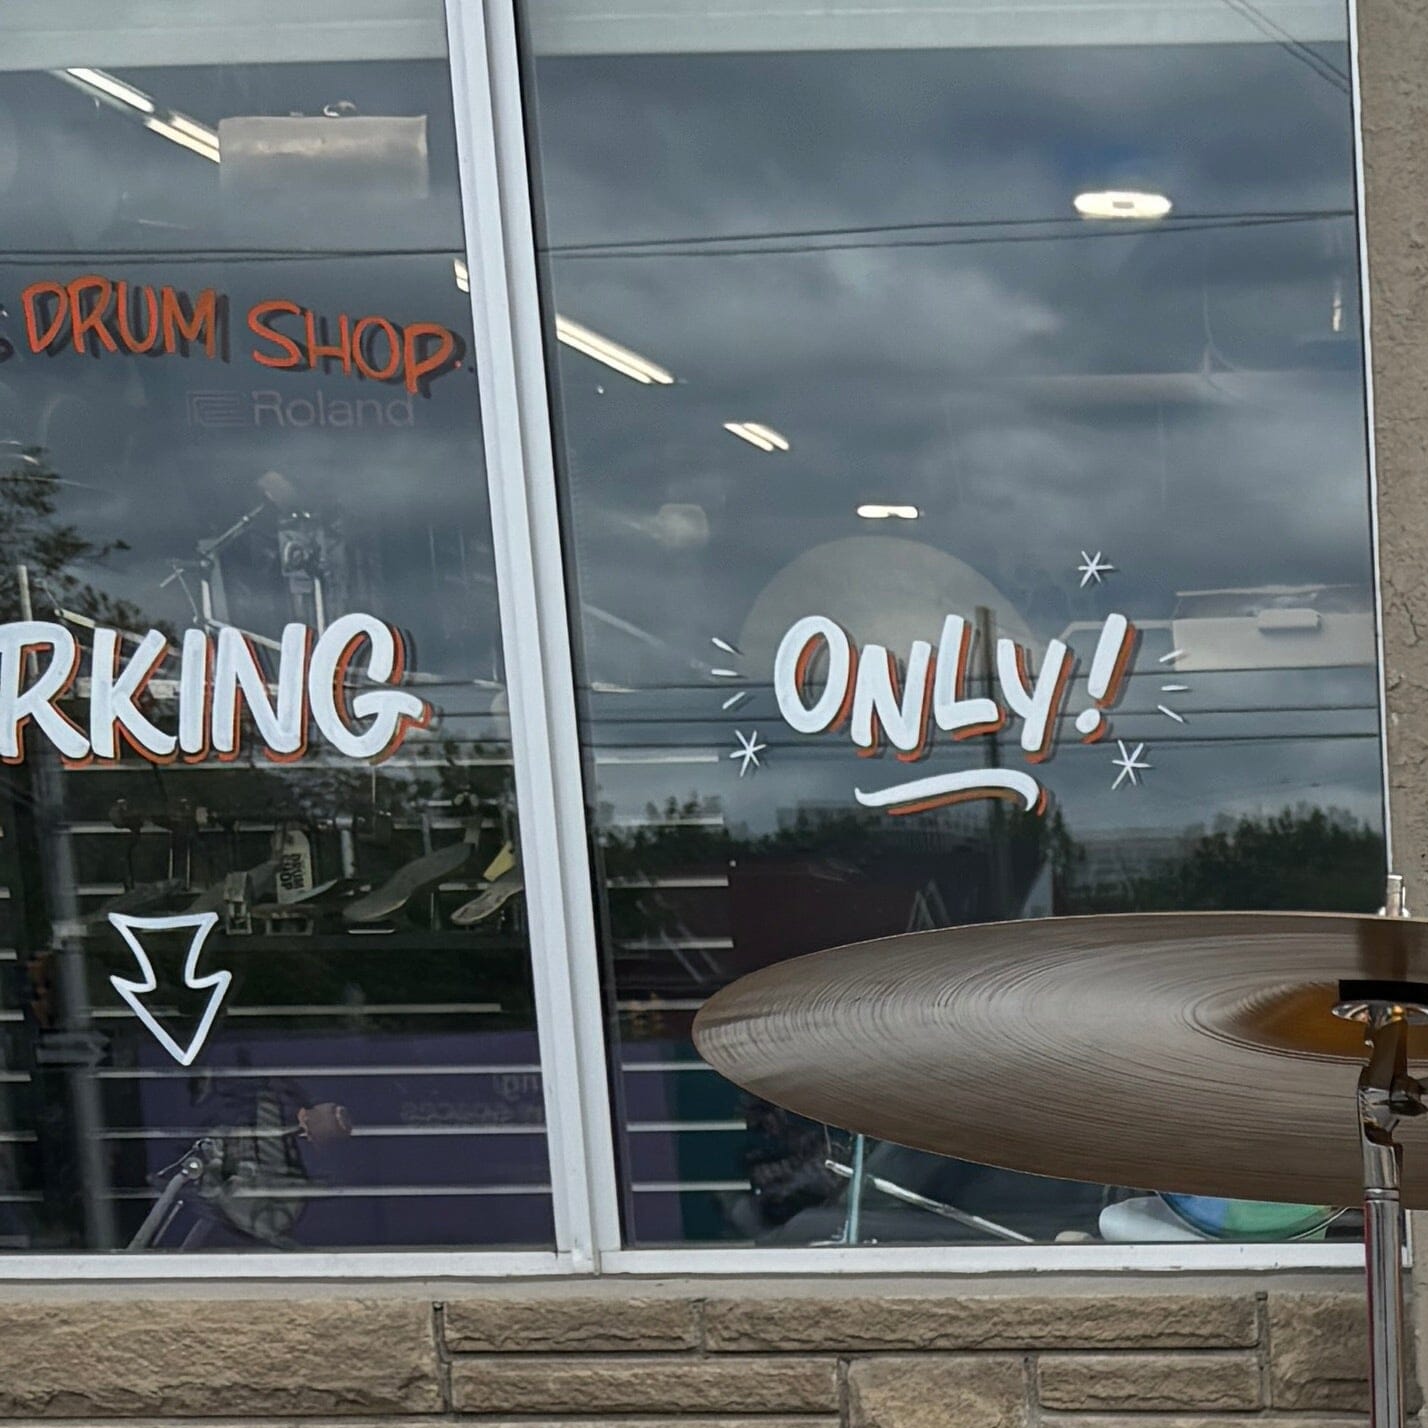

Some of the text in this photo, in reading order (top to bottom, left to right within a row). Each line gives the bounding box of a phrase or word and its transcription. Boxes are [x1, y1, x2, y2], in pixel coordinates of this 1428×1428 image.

[22, 275, 217, 360] DRUM
[254, 390, 414, 427] Roland
[774, 613, 1134, 760] ONLY!
